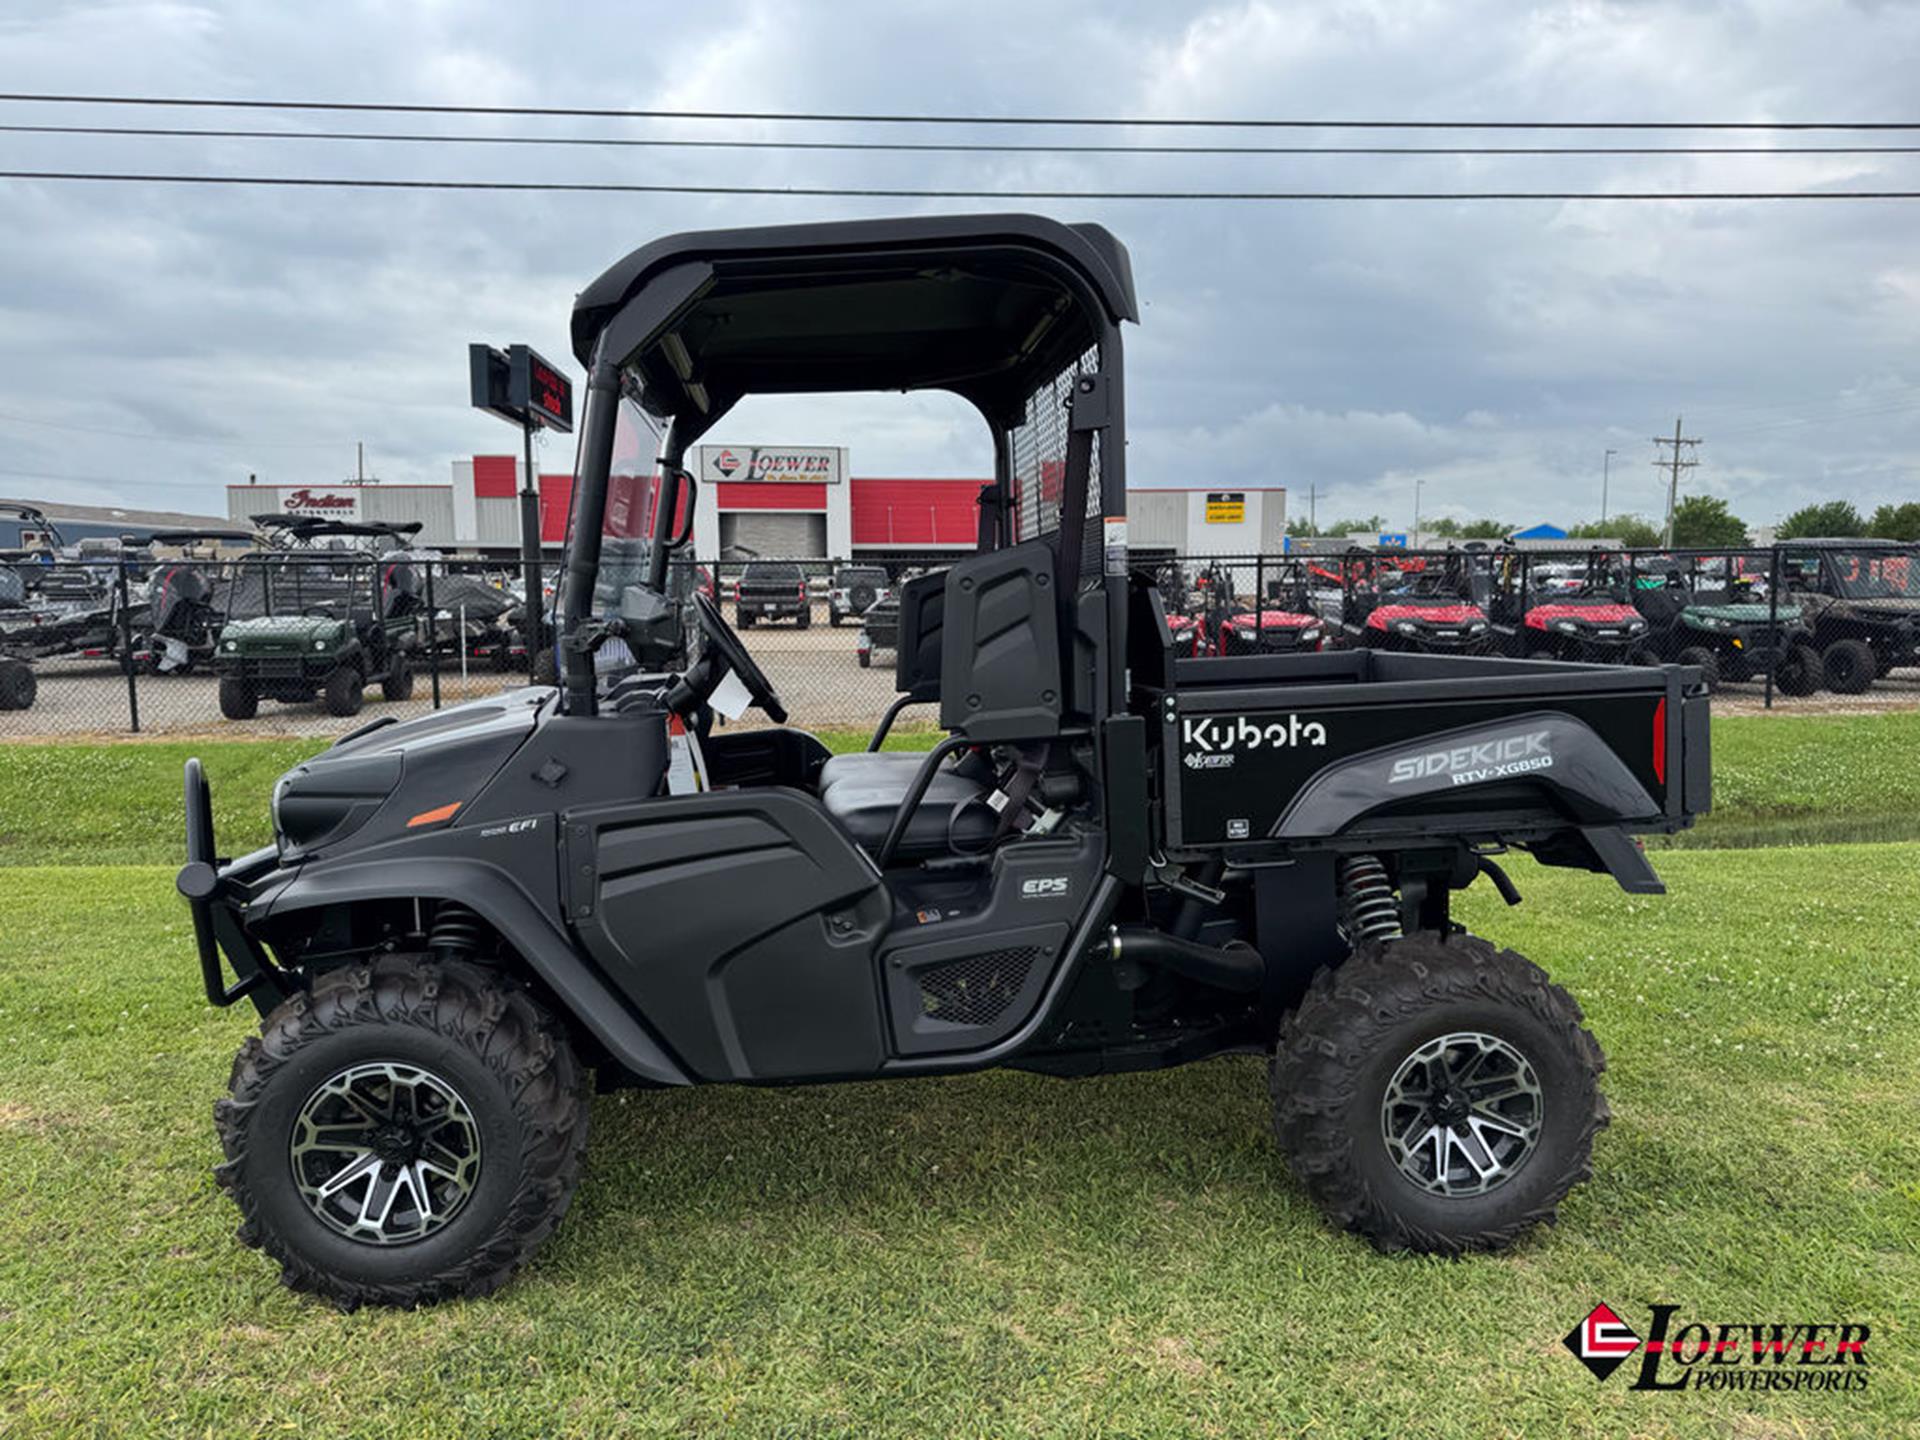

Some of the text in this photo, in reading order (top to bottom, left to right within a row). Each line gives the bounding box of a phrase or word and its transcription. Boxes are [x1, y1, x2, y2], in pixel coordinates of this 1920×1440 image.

[745, 447, 830, 481] LOEWER
[284, 489, 355, 508] Indian
[1184, 714, 1327, 750] Kubota
[1388, 730, 1550, 783] SIDEKICK
[1452, 755, 1553, 785] RTV-XG850
[508, 819, 537, 833] EFI
[1022, 877, 1068, 893] EPS
